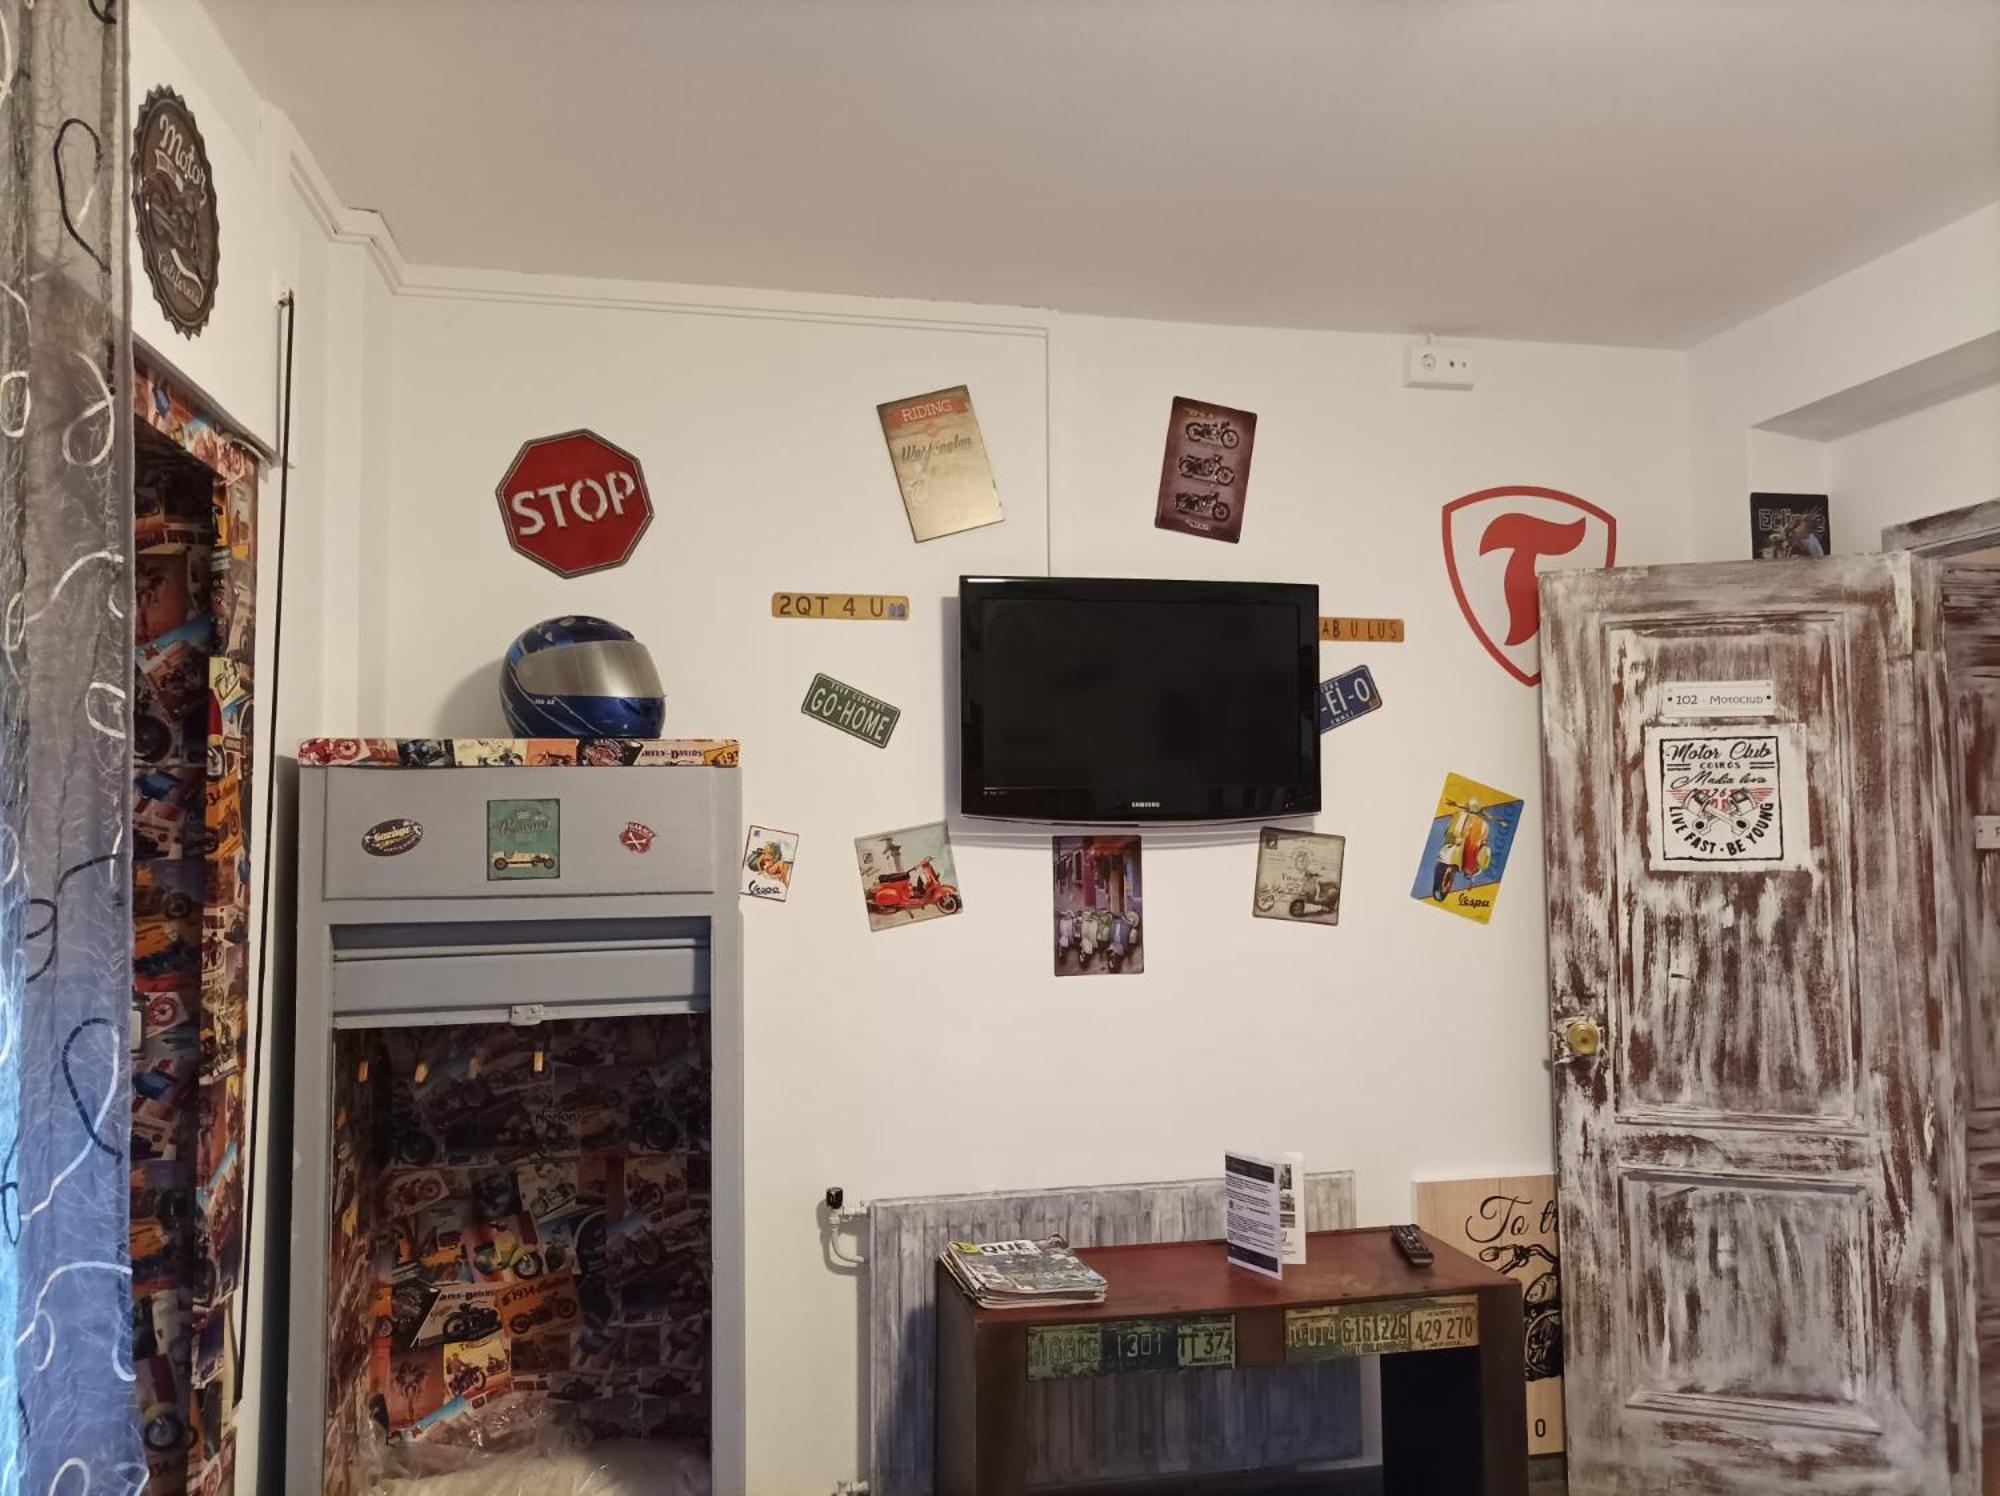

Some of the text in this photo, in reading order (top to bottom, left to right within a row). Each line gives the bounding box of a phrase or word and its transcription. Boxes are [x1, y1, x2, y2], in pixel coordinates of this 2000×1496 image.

[160, 114, 207, 207] Motor
[901, 399, 953, 422] RIDING
[511, 470, 635, 536] STOP
[779, 595, 829, 616] 2QT
[842, 597, 856, 617] 4
[870, 598, 884, 617] U
[1675, 694, 1698, 705] 102
[1666, 740, 1773, 763] Motor Club
[1669, 806, 1688, 834] LIVE
[1684, 832, 1717, 854] FAST
[1726, 839, 1747, 856] BE
[1746, 802, 1775, 845] YOUNG
[748, 880, 783, 896] Vespa
[1458, 892, 1491, 909] Vespa
[1465, 1195, 1534, 1244] To
[1415, 1316, 1473, 1343] 429 270
